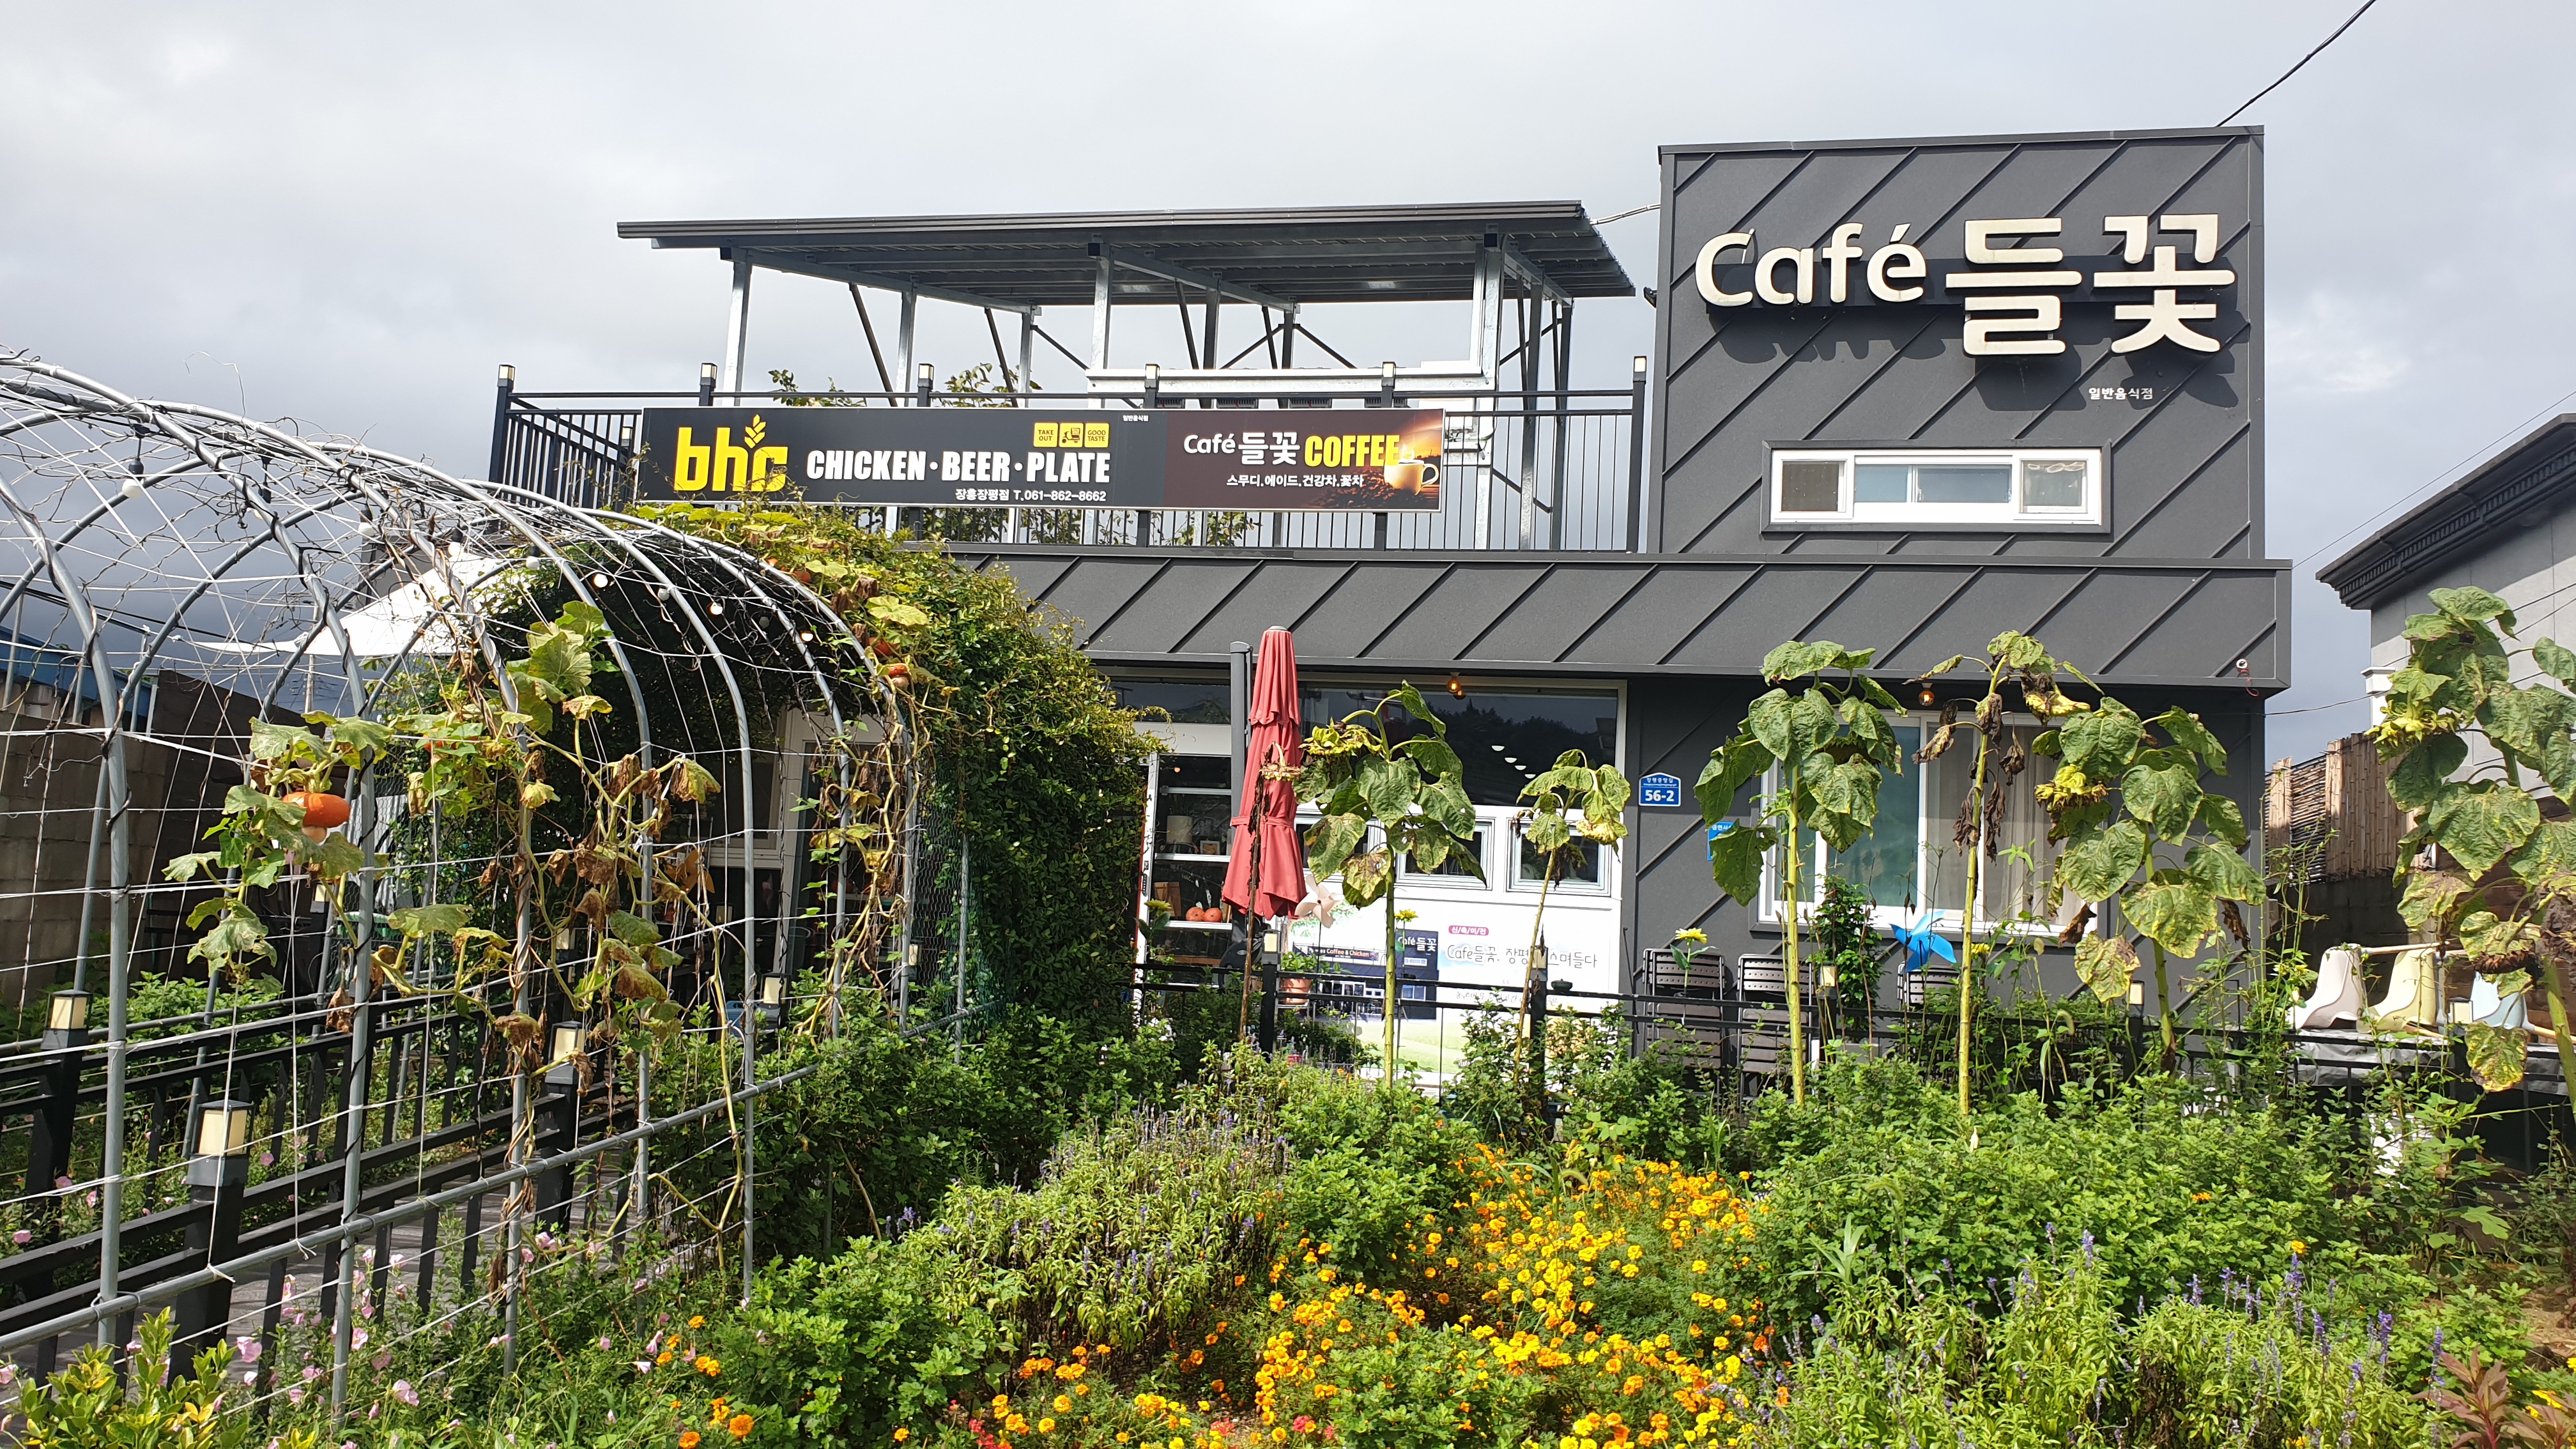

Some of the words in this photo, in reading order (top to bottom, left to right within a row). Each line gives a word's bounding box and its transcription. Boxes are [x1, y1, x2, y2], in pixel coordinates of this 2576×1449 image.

[2089, 387, 2154, 401] 일반음식점
[1304, 435, 1400, 467] COFFEE
[673, 426, 789, 493] bhc
[955, 489, 1009, 501] 장흥장평점
[1645, 790, 1675, 802] 56-2
